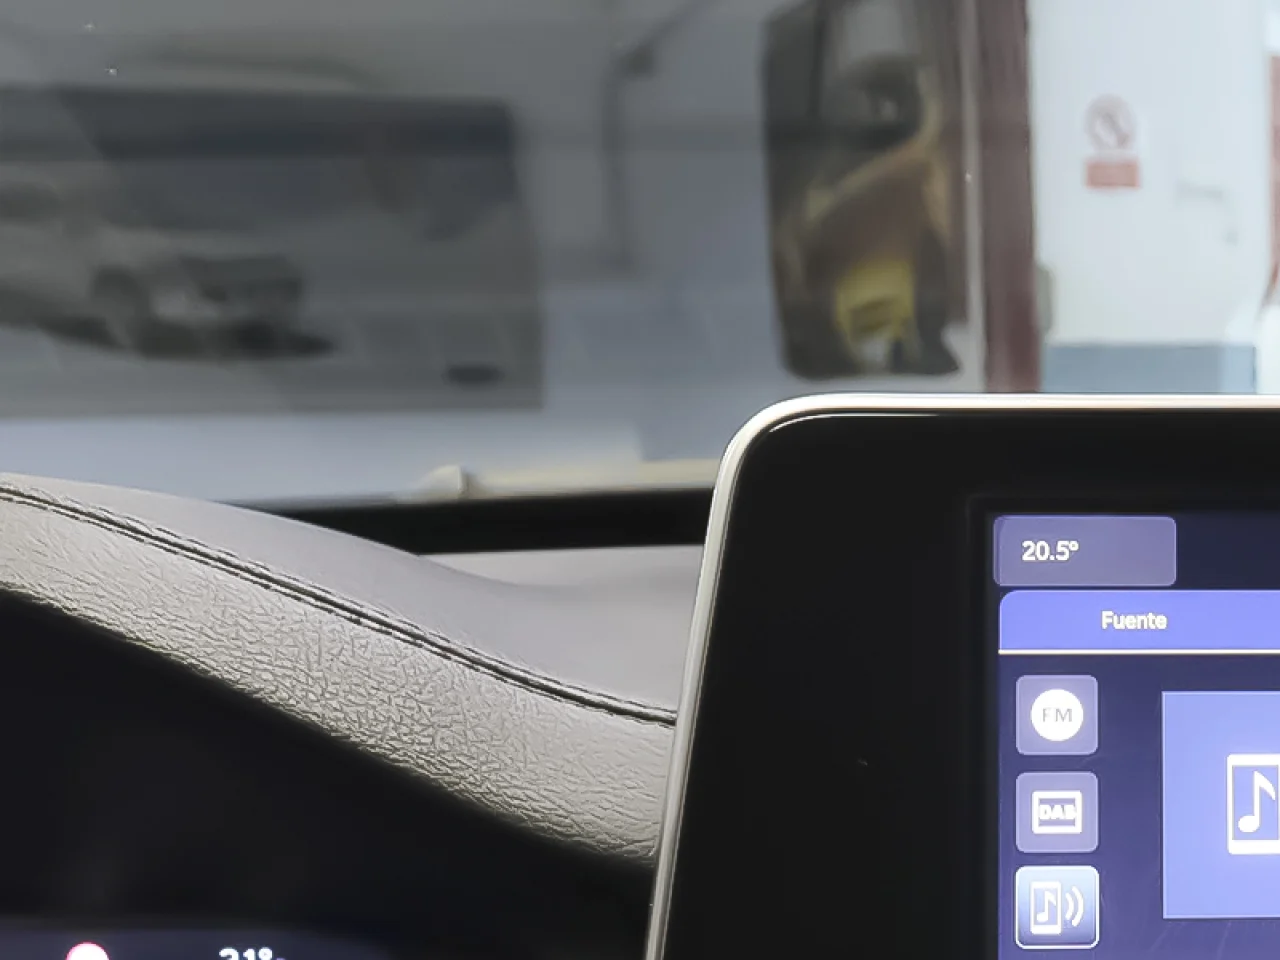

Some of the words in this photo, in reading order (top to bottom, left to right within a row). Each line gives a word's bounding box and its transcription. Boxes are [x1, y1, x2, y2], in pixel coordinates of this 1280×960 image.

[1101, 611, 1167, 630] Fuente
[1041, 706, 1073, 724] FM
[1039, 804, 1077, 821] DAB
